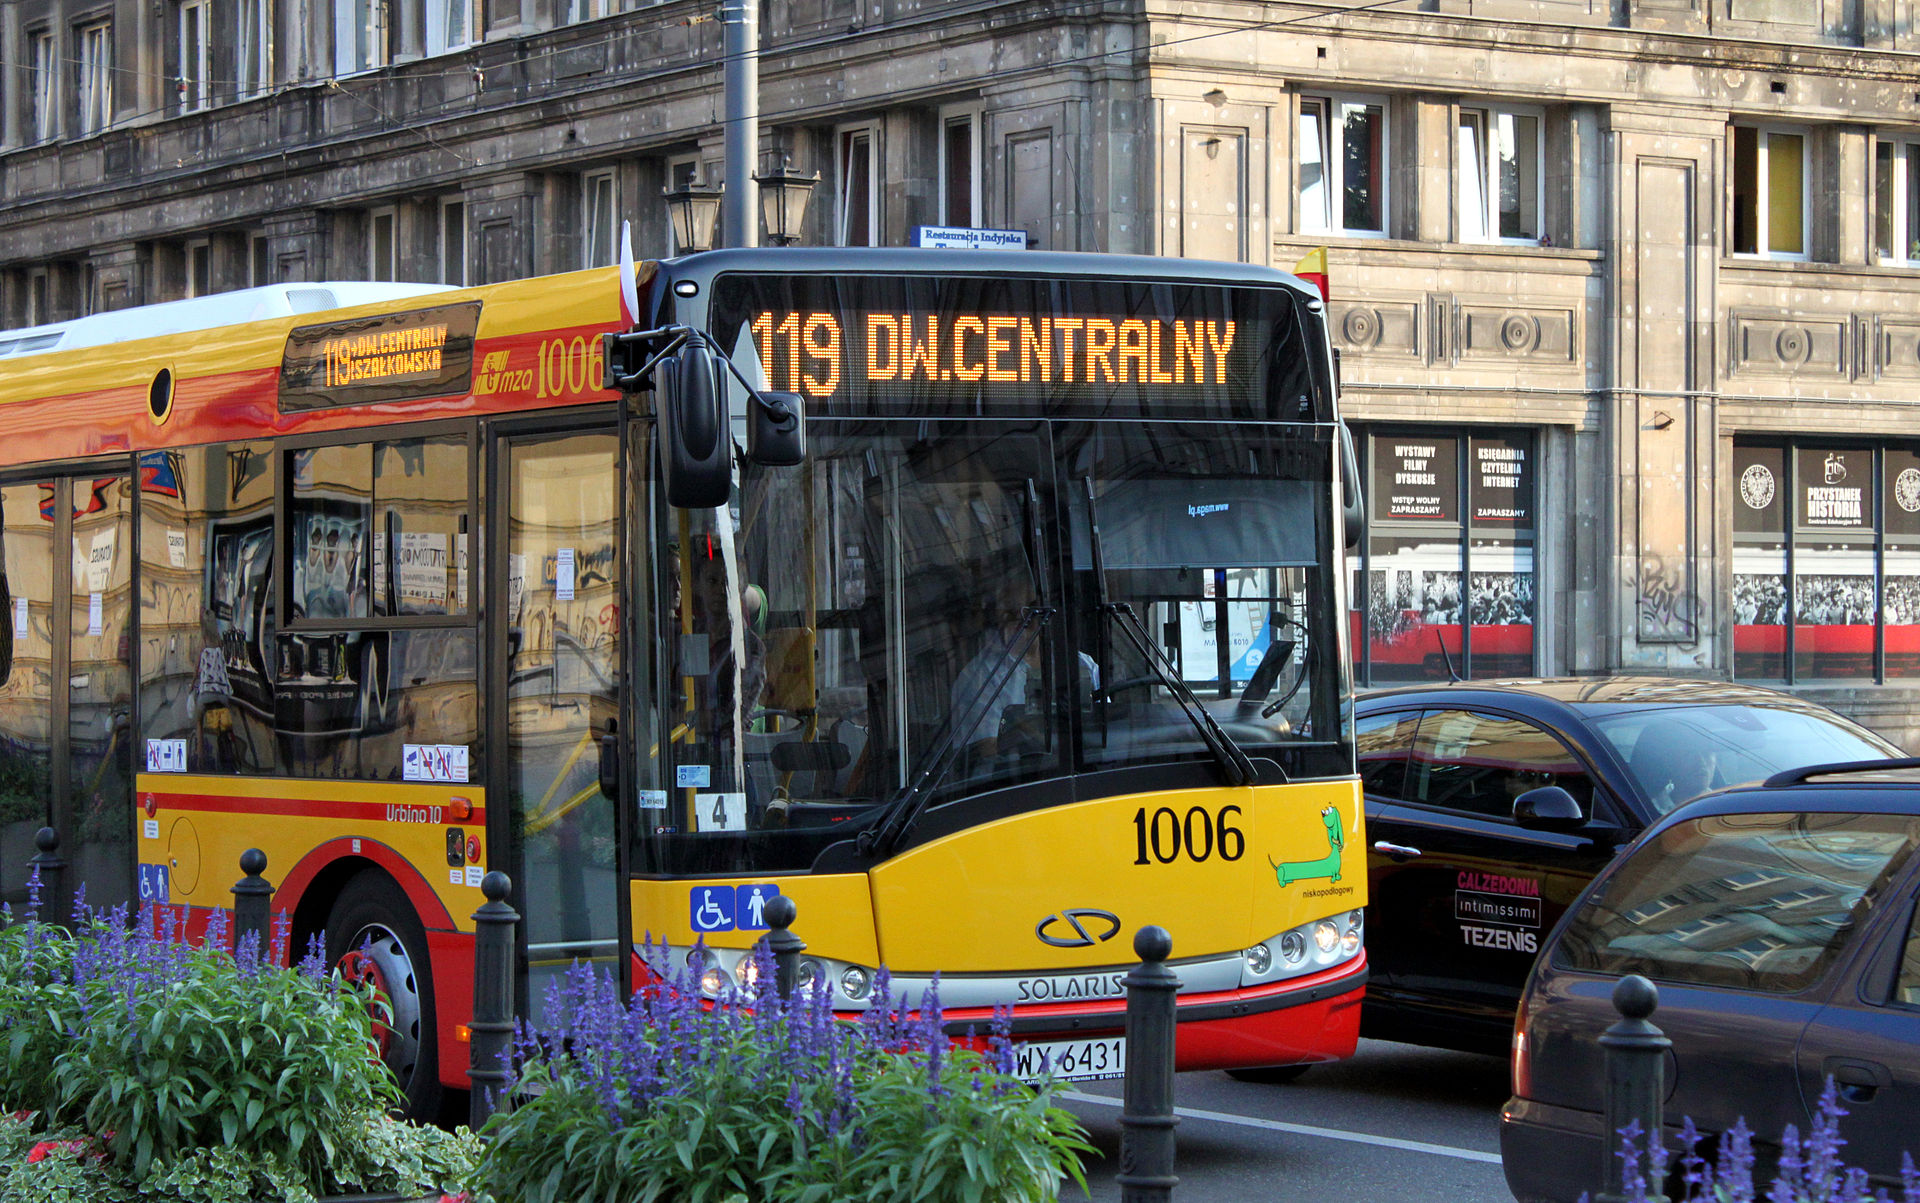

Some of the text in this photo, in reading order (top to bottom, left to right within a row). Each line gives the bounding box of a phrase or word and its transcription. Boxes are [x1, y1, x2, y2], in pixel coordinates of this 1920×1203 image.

[926, 230, 1021, 245] Restauracja Indyjska
[752, 312, 1236, 396] 119 DW.CENTRALNY
[323, 340, 351, 387] 119
[499, 333, 604, 398] mza 1006
[1395, 445, 1436, 458] WYSTAWY
[1478, 448, 1525, 461] KSIĘGARNIA
[1403, 459, 1428, 471] FILMY
[1481, 462, 1522, 474] CZYTELNIA
[1395, 473, 1436, 486] DYSKUSJE
[1483, 475, 1520, 488] INTERNET
[1391, 496, 1440, 505] WSTĘP WOLNY
[1807, 487, 1862, 500] PRZYSTANEK
[1391, 506, 1440, 514] ZAPRASZAMY
[1477, 508, 1525, 517] ZAPRASZAMY
[1807, 501, 1862, 518] HISTORIA
[386, 804, 442, 825] Urbino 10
[712, 795, 728, 829] 4
[1133, 804, 1245, 866] 1006
[1457, 871, 1539, 896] CALZEDONIA
[1018, 975, 1125, 1000] SOLARIS
